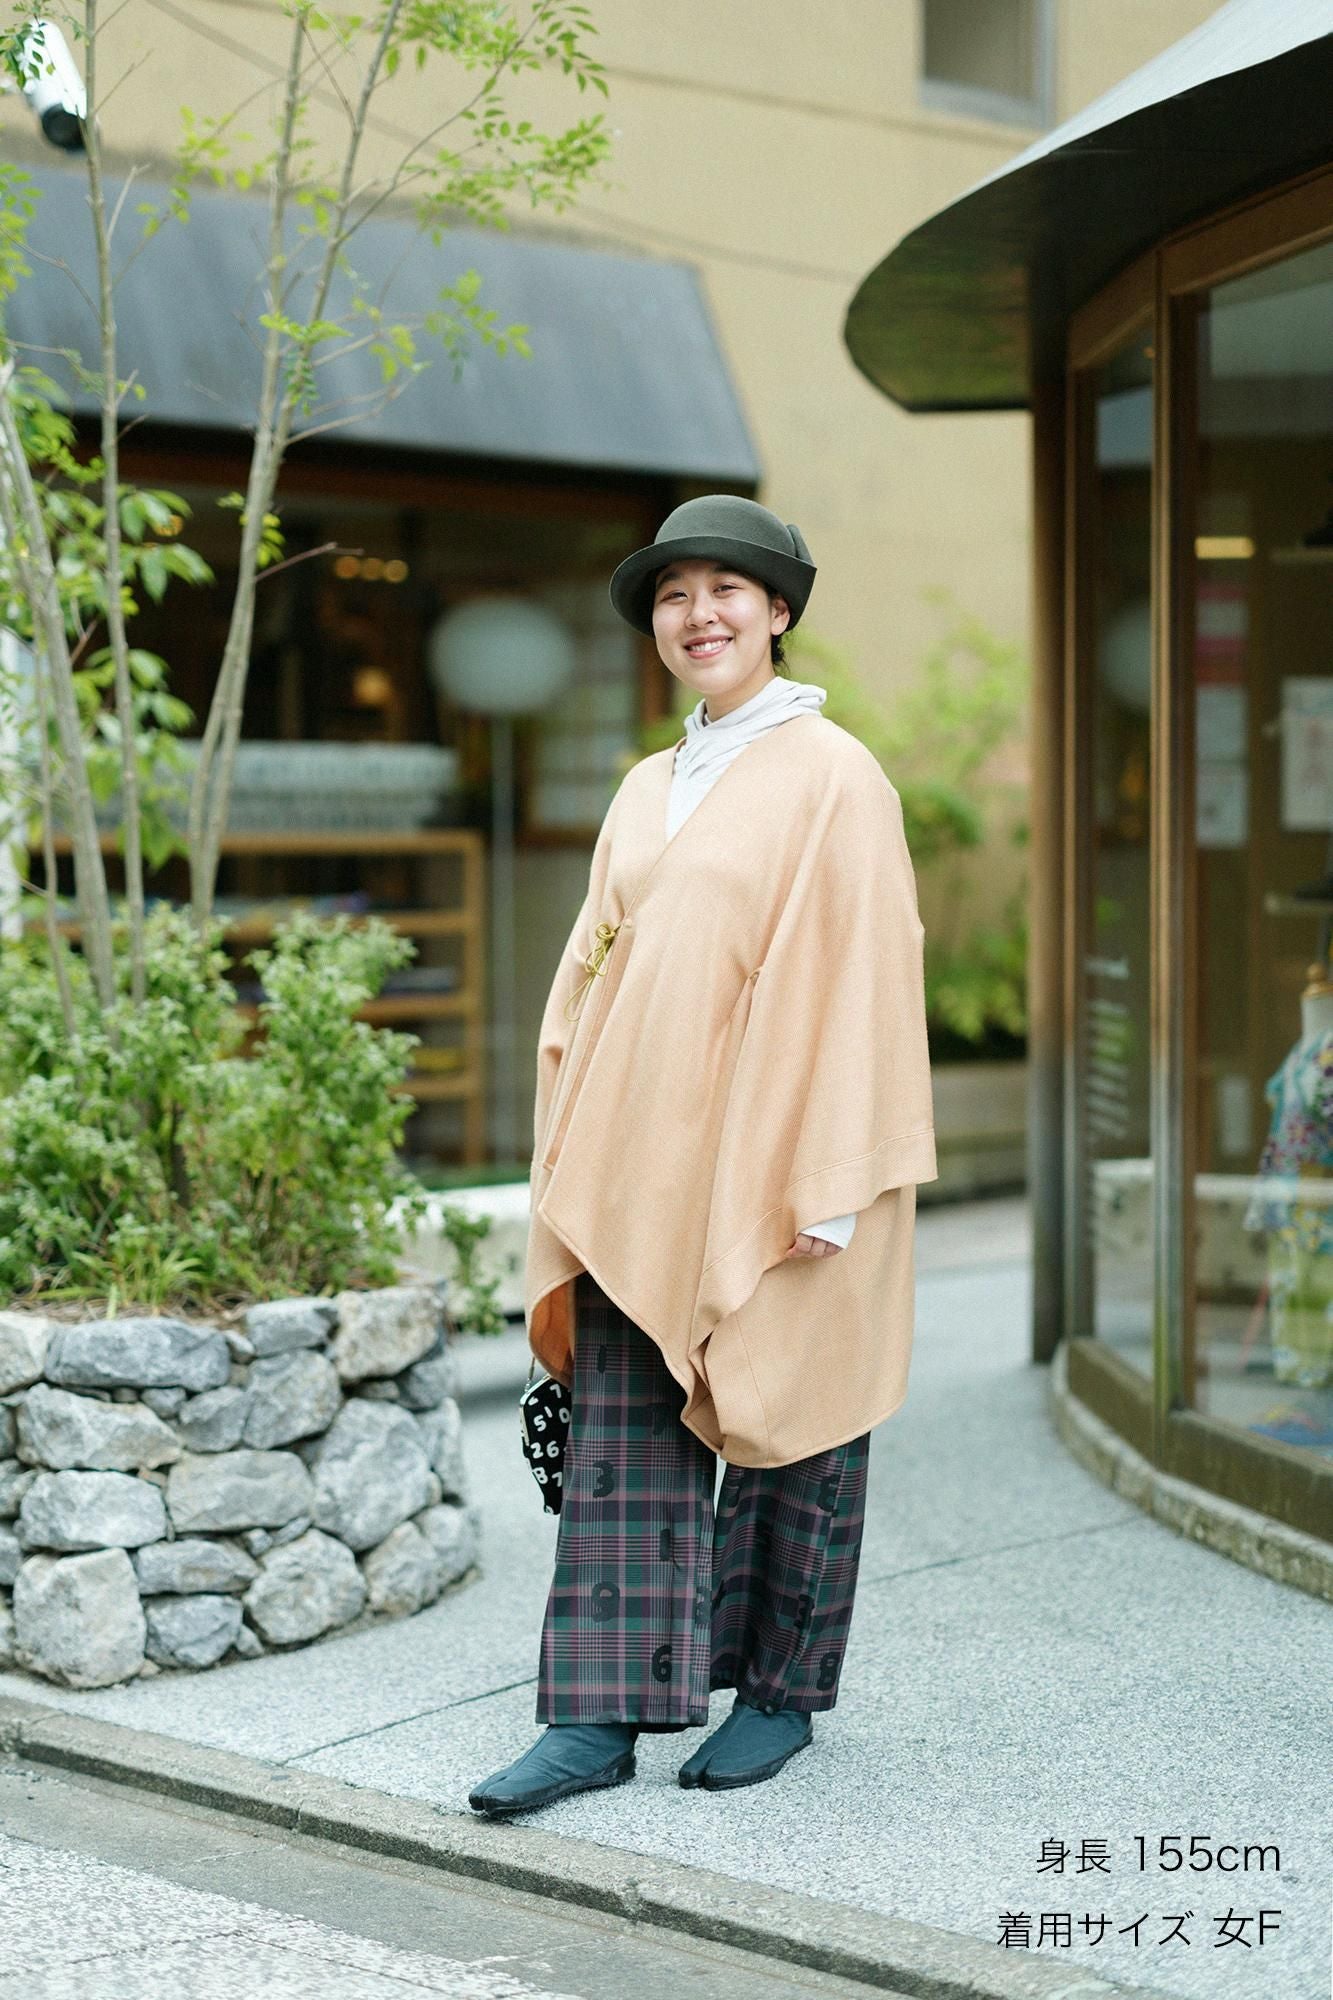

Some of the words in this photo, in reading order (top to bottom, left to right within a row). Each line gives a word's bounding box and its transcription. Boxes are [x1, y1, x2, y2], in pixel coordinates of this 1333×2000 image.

[592, 1460, 615, 1498] 3
[591, 1581, 620, 1622] 9
[651, 1644, 673, 1683] 6
